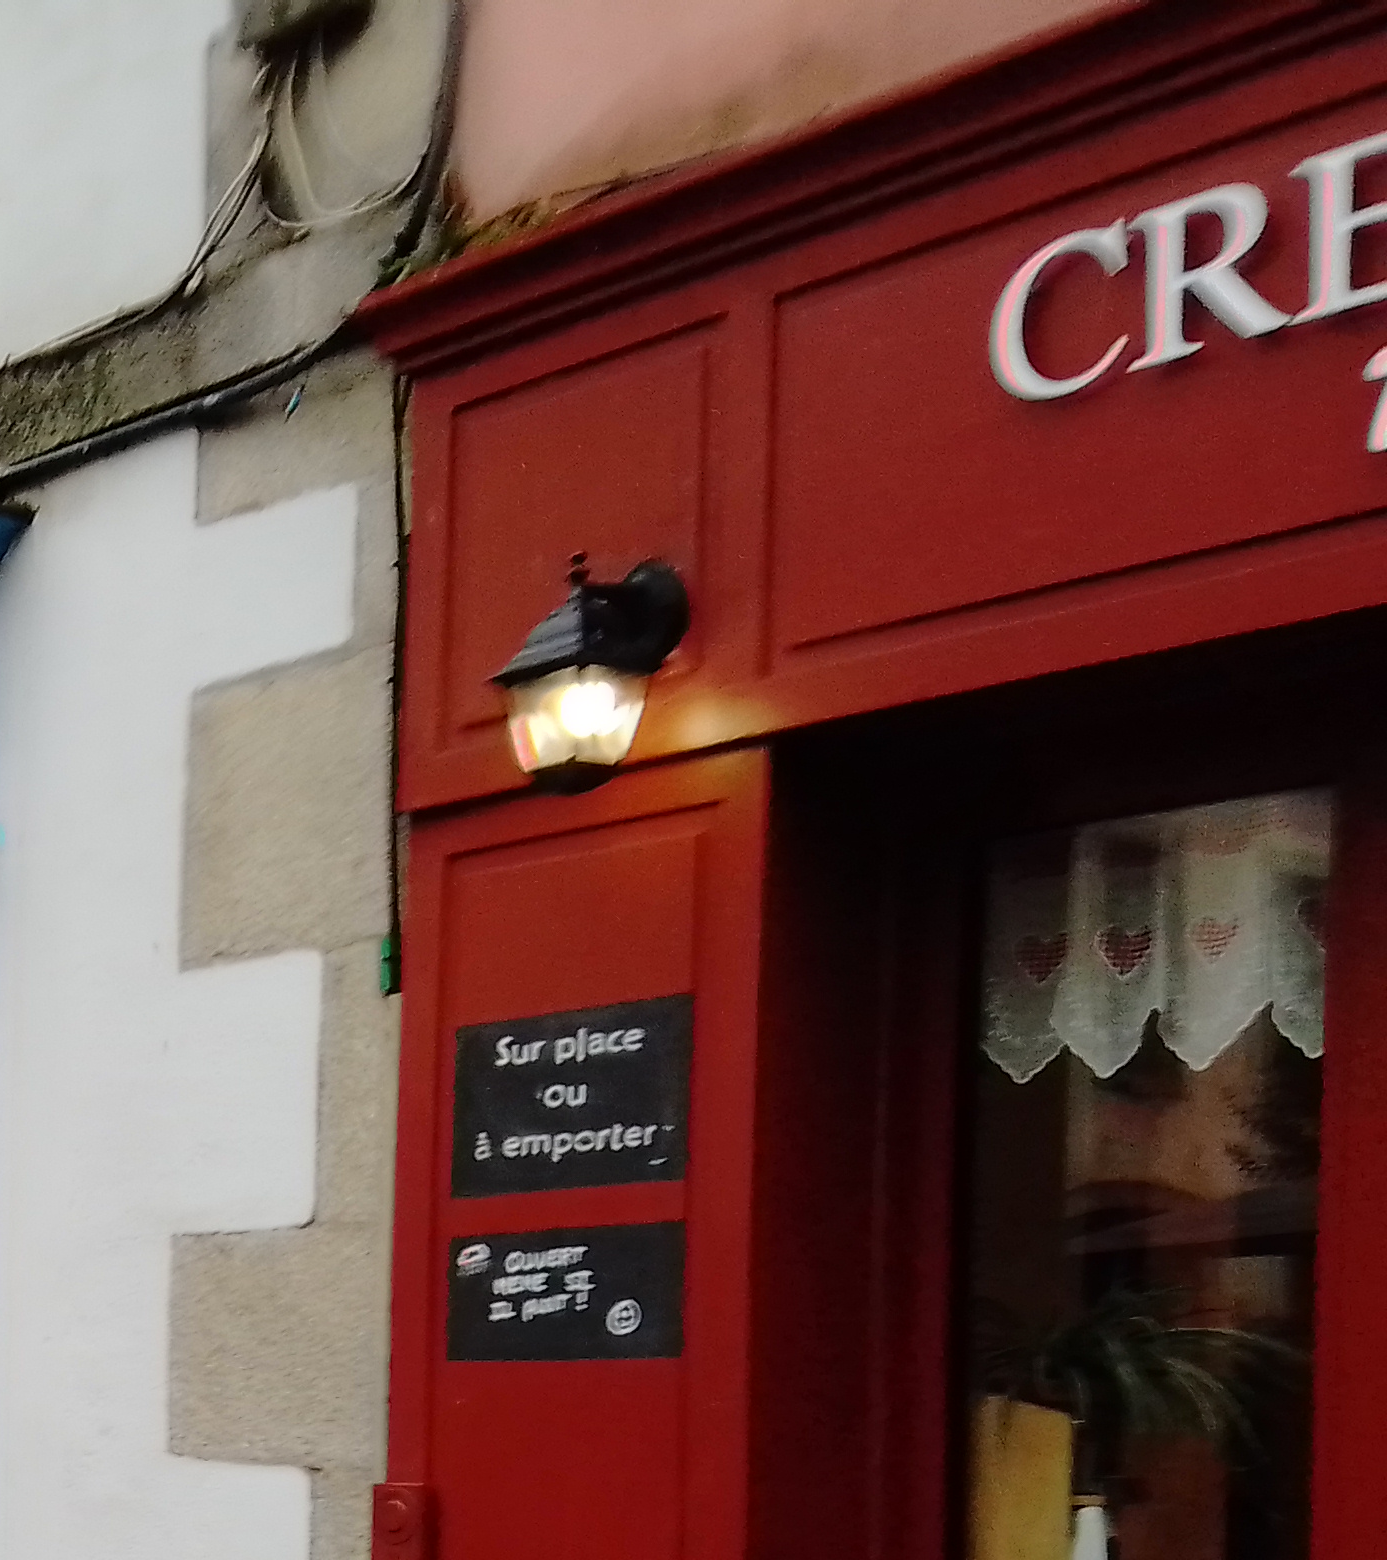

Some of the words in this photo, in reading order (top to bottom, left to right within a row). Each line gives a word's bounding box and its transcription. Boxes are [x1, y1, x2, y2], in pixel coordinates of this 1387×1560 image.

[494, 1035, 547, 1067] Sur
[553, 1027, 645, 1065] place
[542, 1083, 588, 1109] ou
[501, 1122, 659, 1162] emporter
